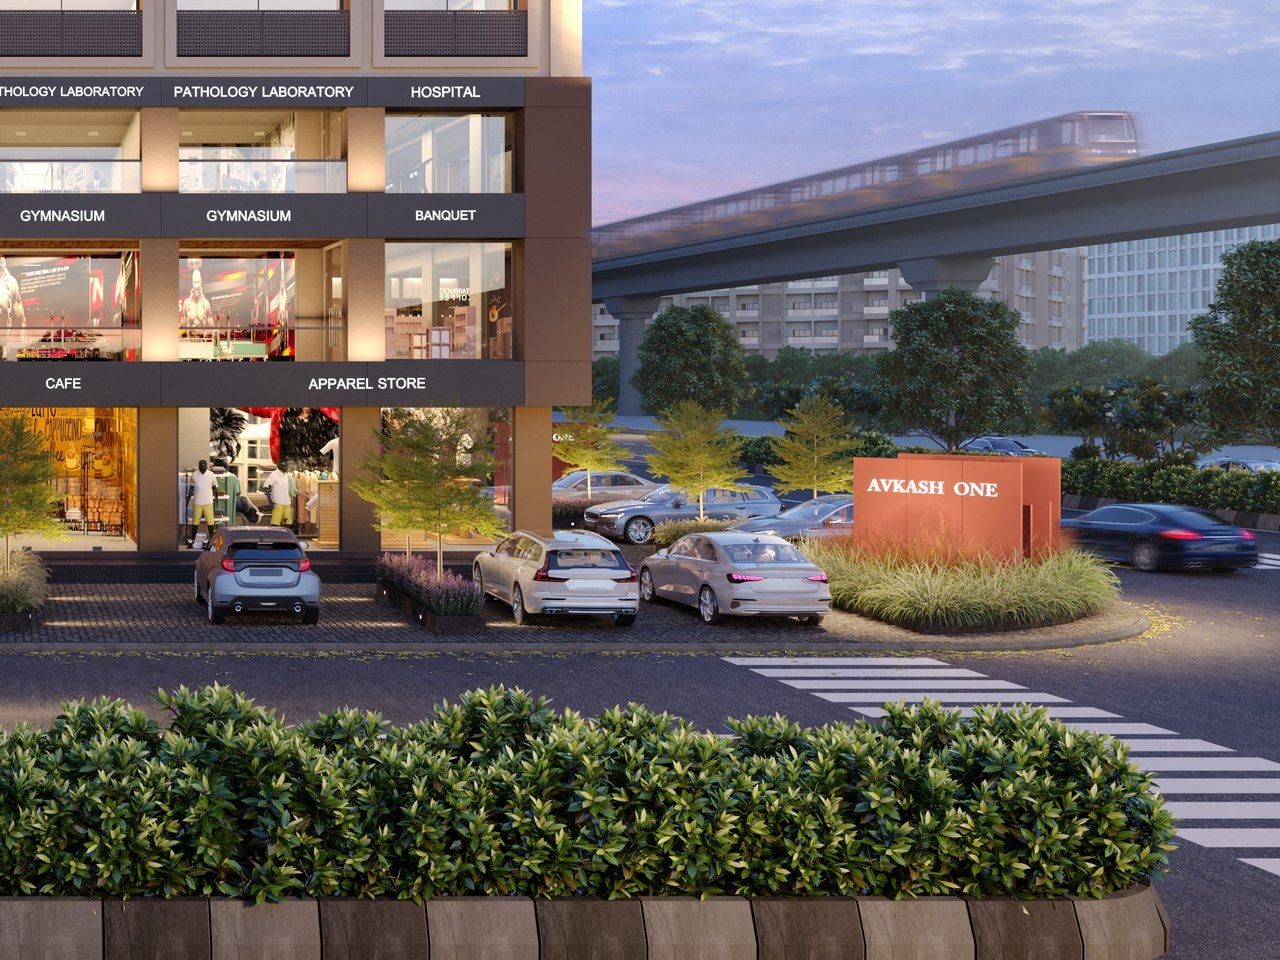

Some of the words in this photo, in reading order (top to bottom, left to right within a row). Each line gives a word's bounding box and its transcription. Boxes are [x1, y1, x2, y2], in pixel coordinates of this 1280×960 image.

[60, 85, 145, 97] LABORATORY
[173, 85, 258, 98] PATHOLOGY
[261, 85, 355, 98] LABORATORY
[411, 85, 481, 98] HOSPITAL
[20, 209, 105, 222] GYMNASIUM
[206, 209, 292, 222] GYMNASIUM
[415, 209, 477, 222] BANQUET
[45, 377, 82, 390] CAFE
[308, 377, 374, 390] APPAREL
[377, 377, 427, 390] STORE
[866, 478, 945, 495] AVKASH
[953, 481, 999, 498] ONE
